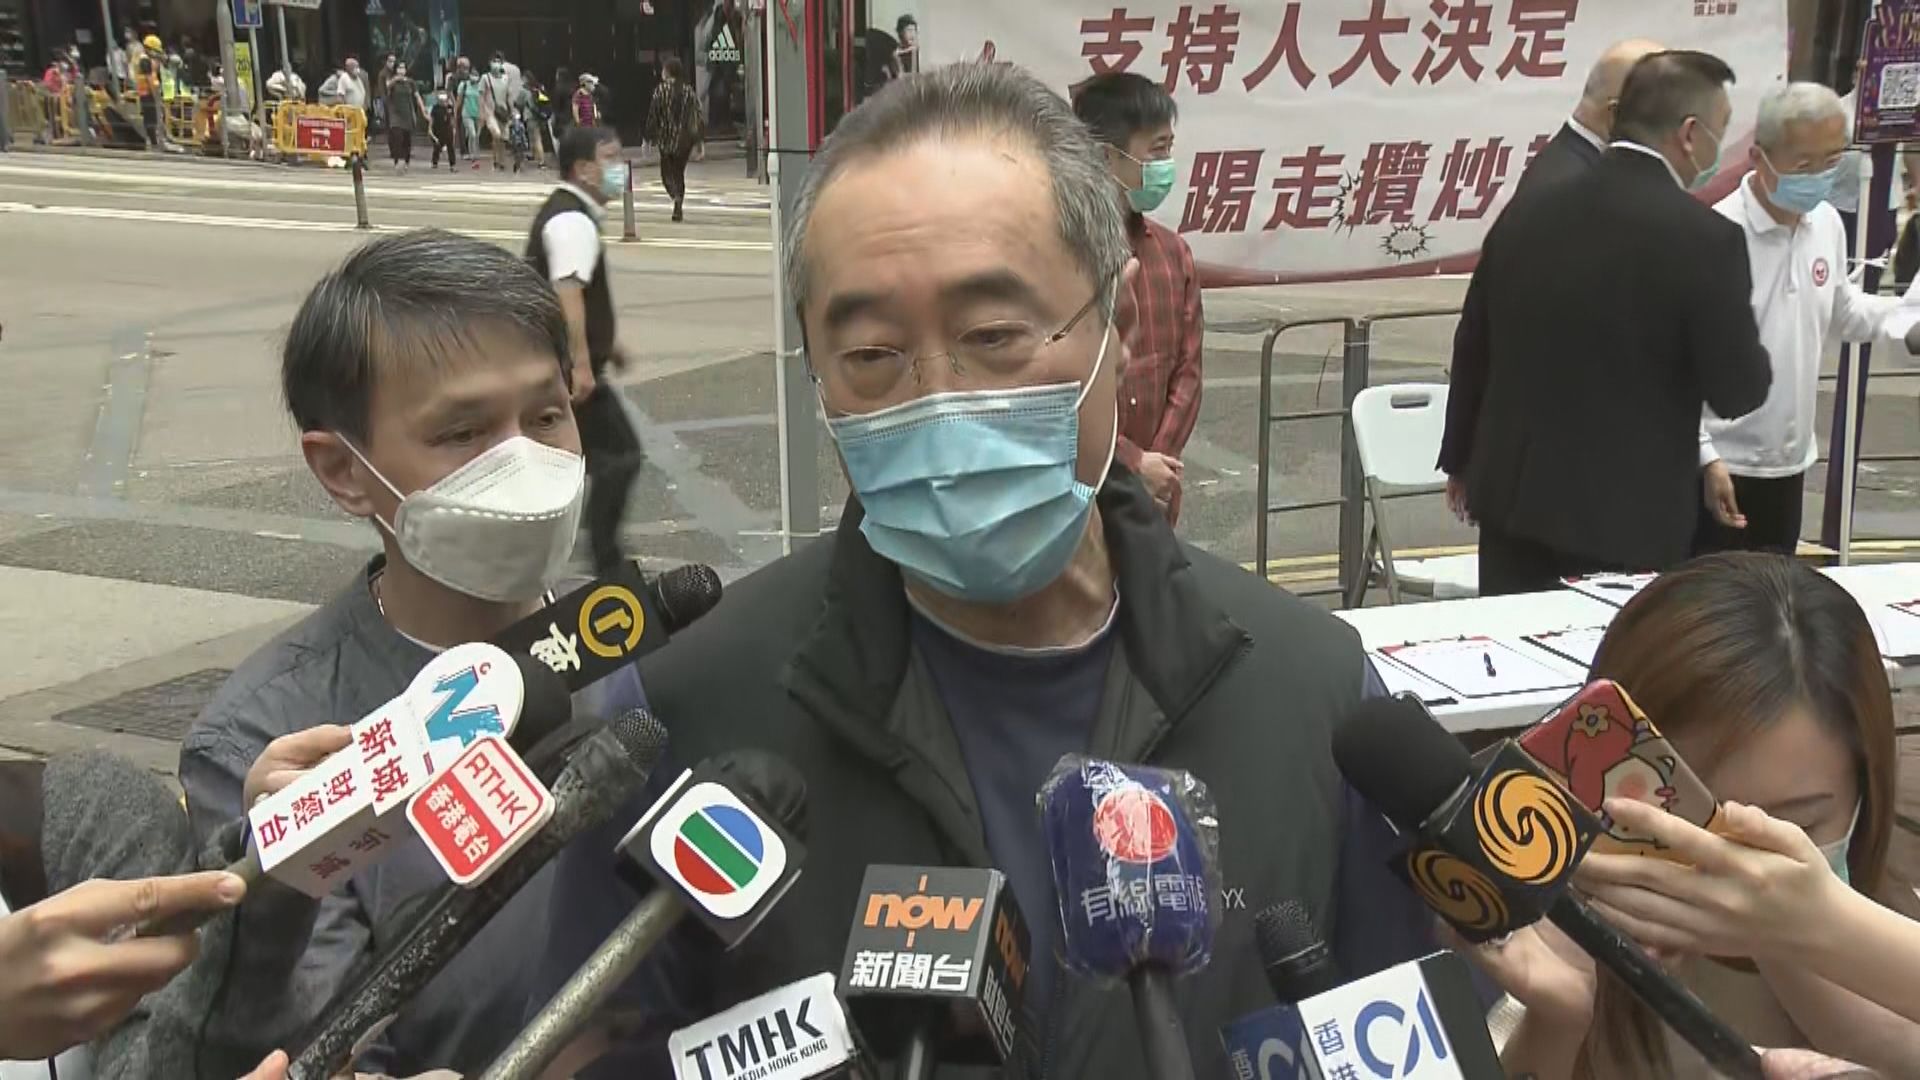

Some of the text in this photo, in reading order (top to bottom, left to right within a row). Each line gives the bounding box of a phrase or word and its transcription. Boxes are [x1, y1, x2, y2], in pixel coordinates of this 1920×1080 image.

[708, 49, 741, 61] adidas
[1068, 0, 1579, 95] 支持人大決定
[1177, 134, 1553, 234] 踢走攬炒
[358, 717, 409, 803] 新城
[464, 751, 528, 827] RTHK
[258, 767, 357, 849] 財經台
[425, 783, 491, 864] 香港電台
[863, 892, 985, 932] now
[849, 950, 973, 992] 新聞台
[685, 996, 824, 1080] TMHK
[769, 1052, 799, 1072] HONG
[799, 1037, 829, 1059] KONG
